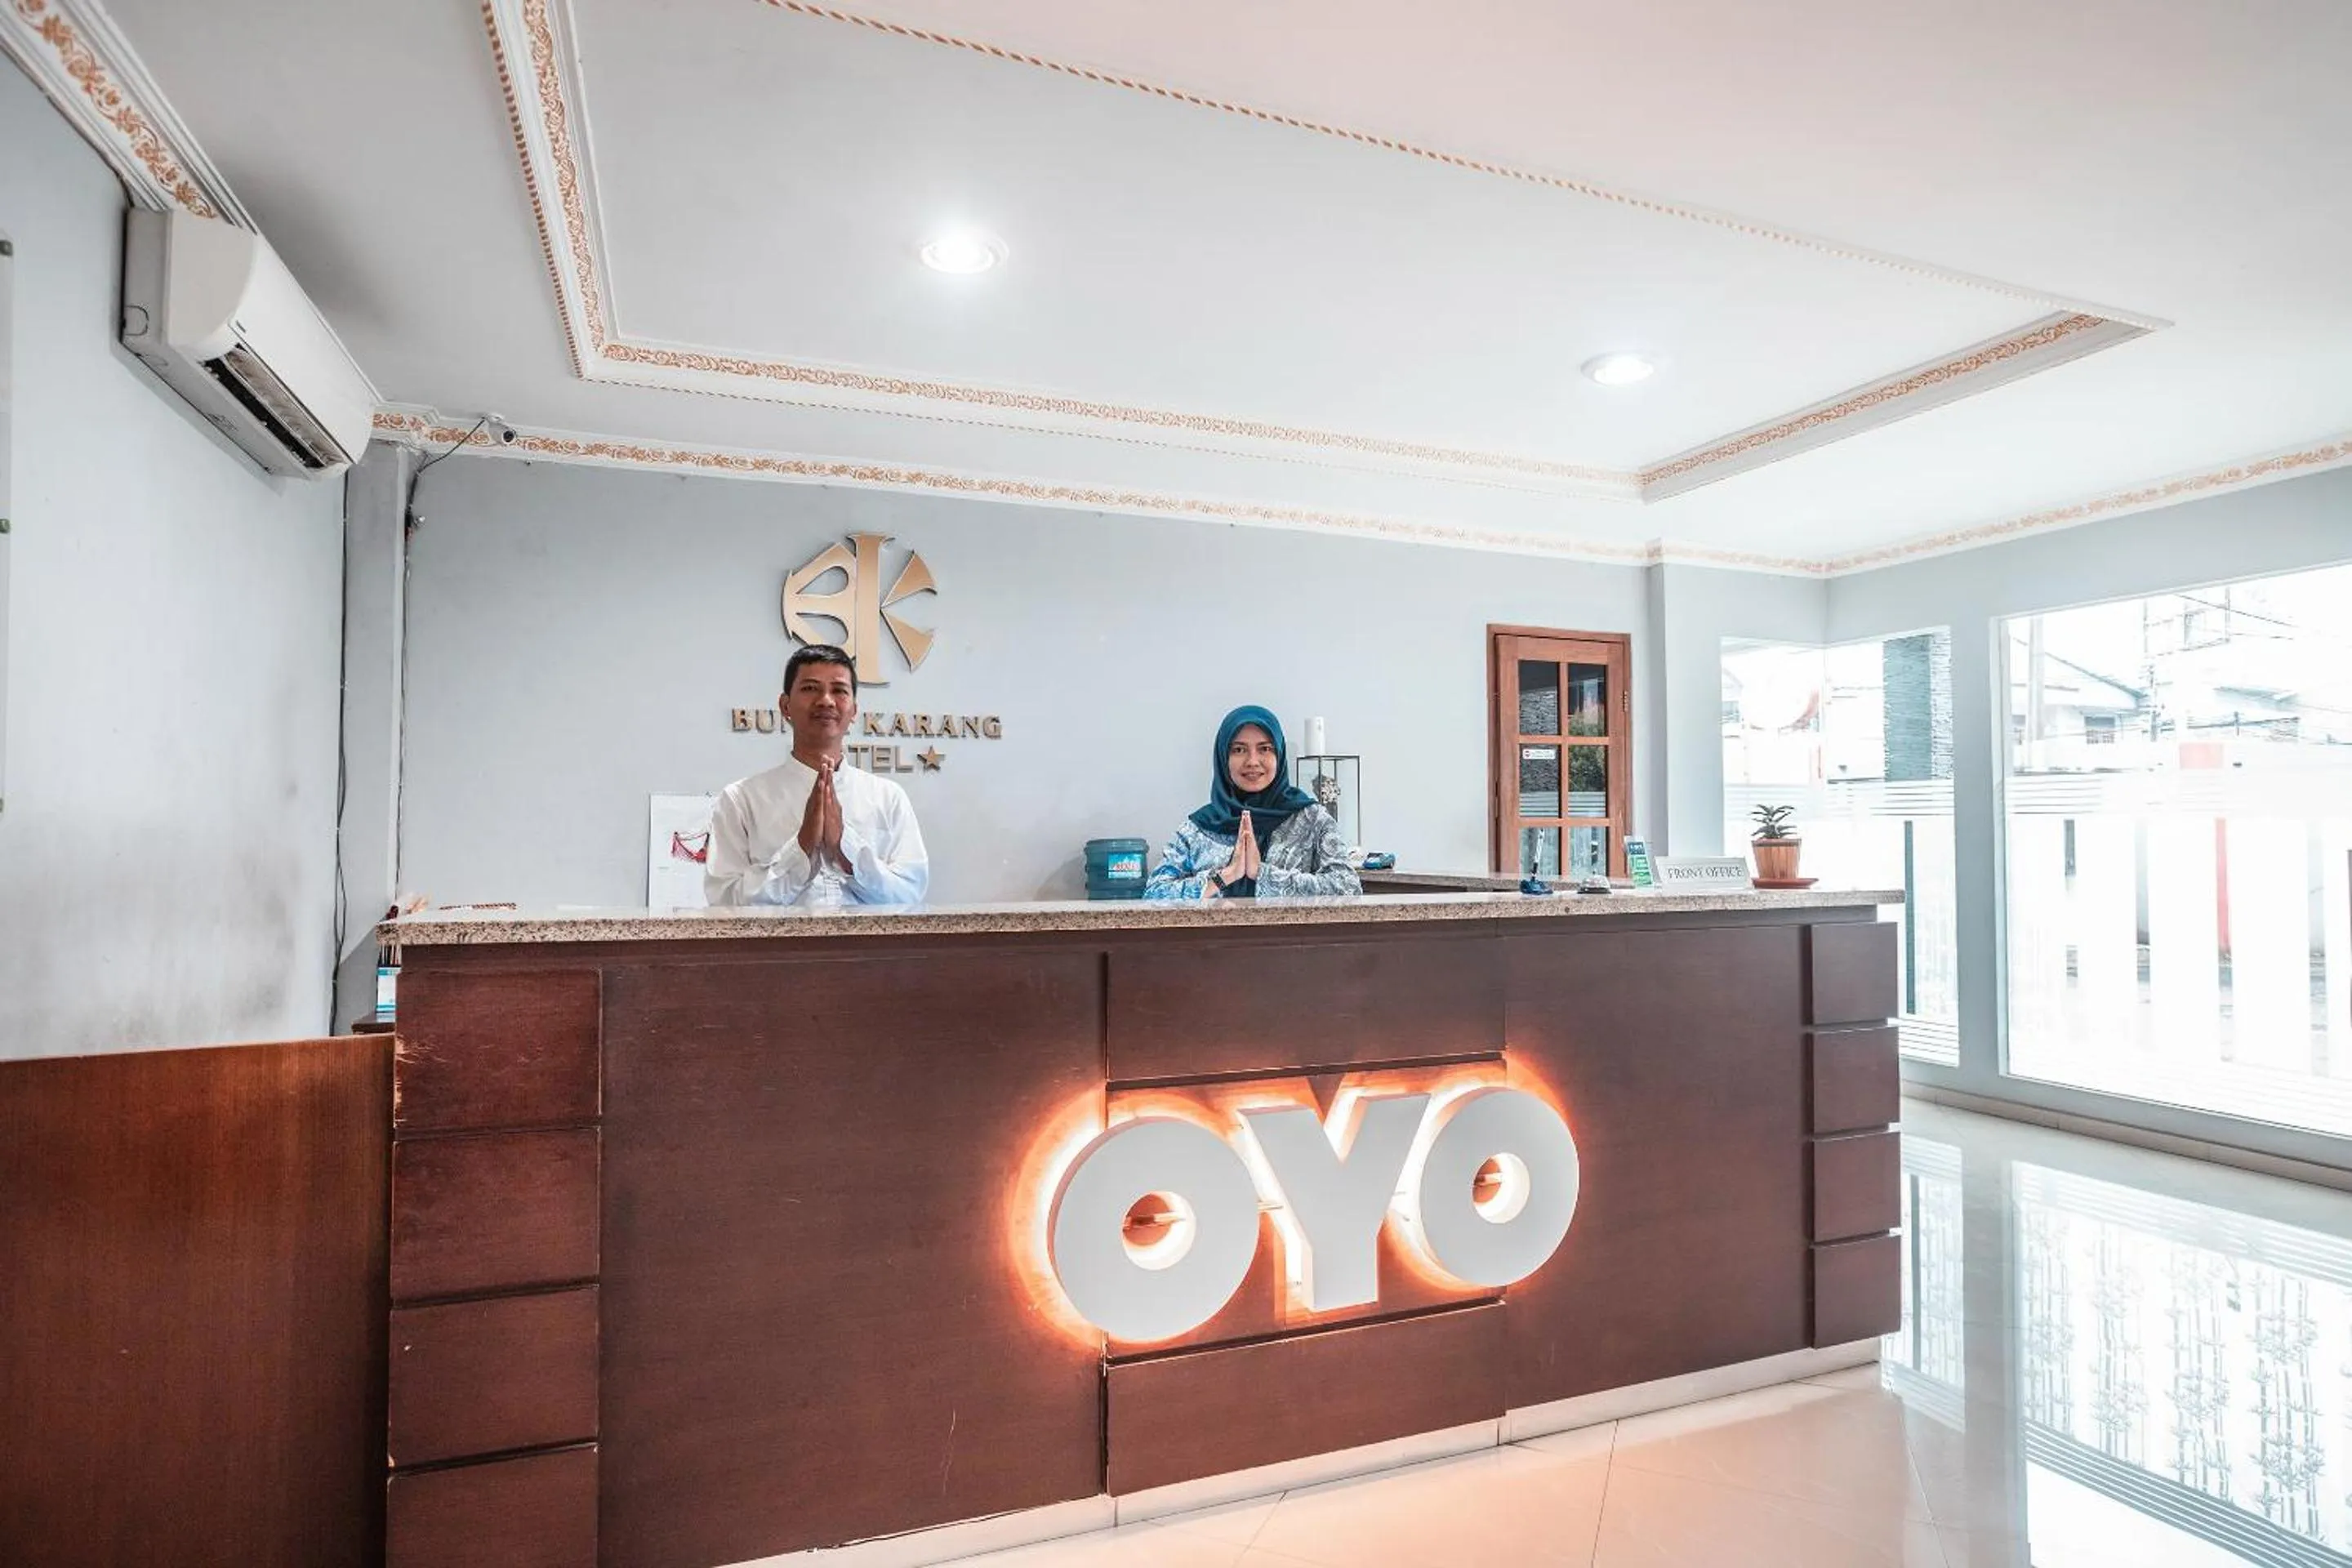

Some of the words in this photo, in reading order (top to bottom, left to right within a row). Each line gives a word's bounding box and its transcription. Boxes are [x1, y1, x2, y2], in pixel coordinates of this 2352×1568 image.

[862, 712, 1002, 739] KARANG
[848, 744, 914, 773] TEL
[1668, 867, 1704, 879] FRONT
[1705, 866, 1744, 878] OFFICE
[1047, 1085, 1579, 1341] OYO
